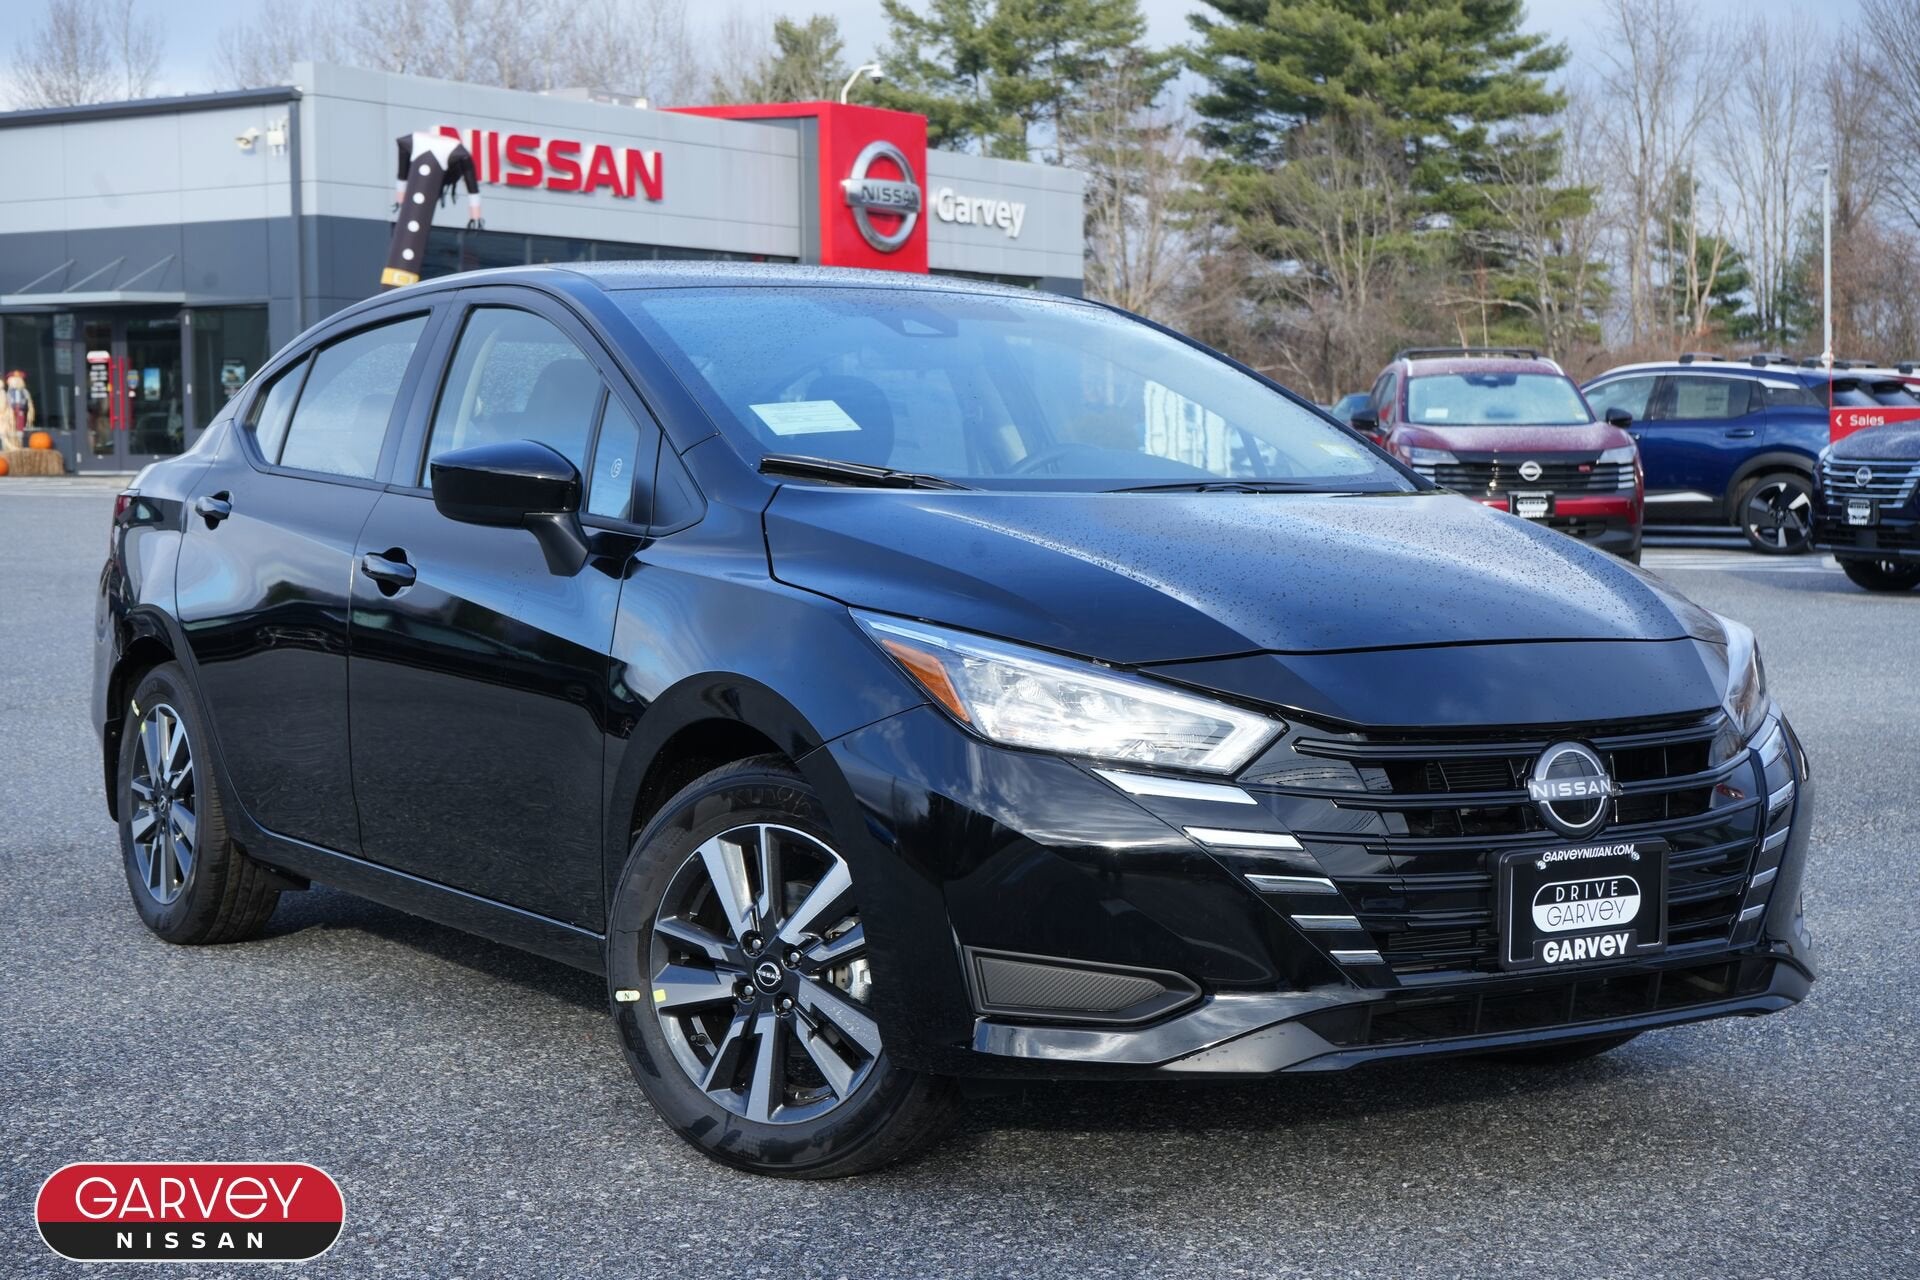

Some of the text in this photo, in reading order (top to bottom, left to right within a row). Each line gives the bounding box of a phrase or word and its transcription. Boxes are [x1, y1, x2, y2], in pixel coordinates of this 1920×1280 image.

[937, 188, 1026, 239] Garvey
[1849, 413, 1885, 427] Sales
[1532, 778, 1612, 799] NISSAN
[1555, 880, 1619, 903] DRIVE
